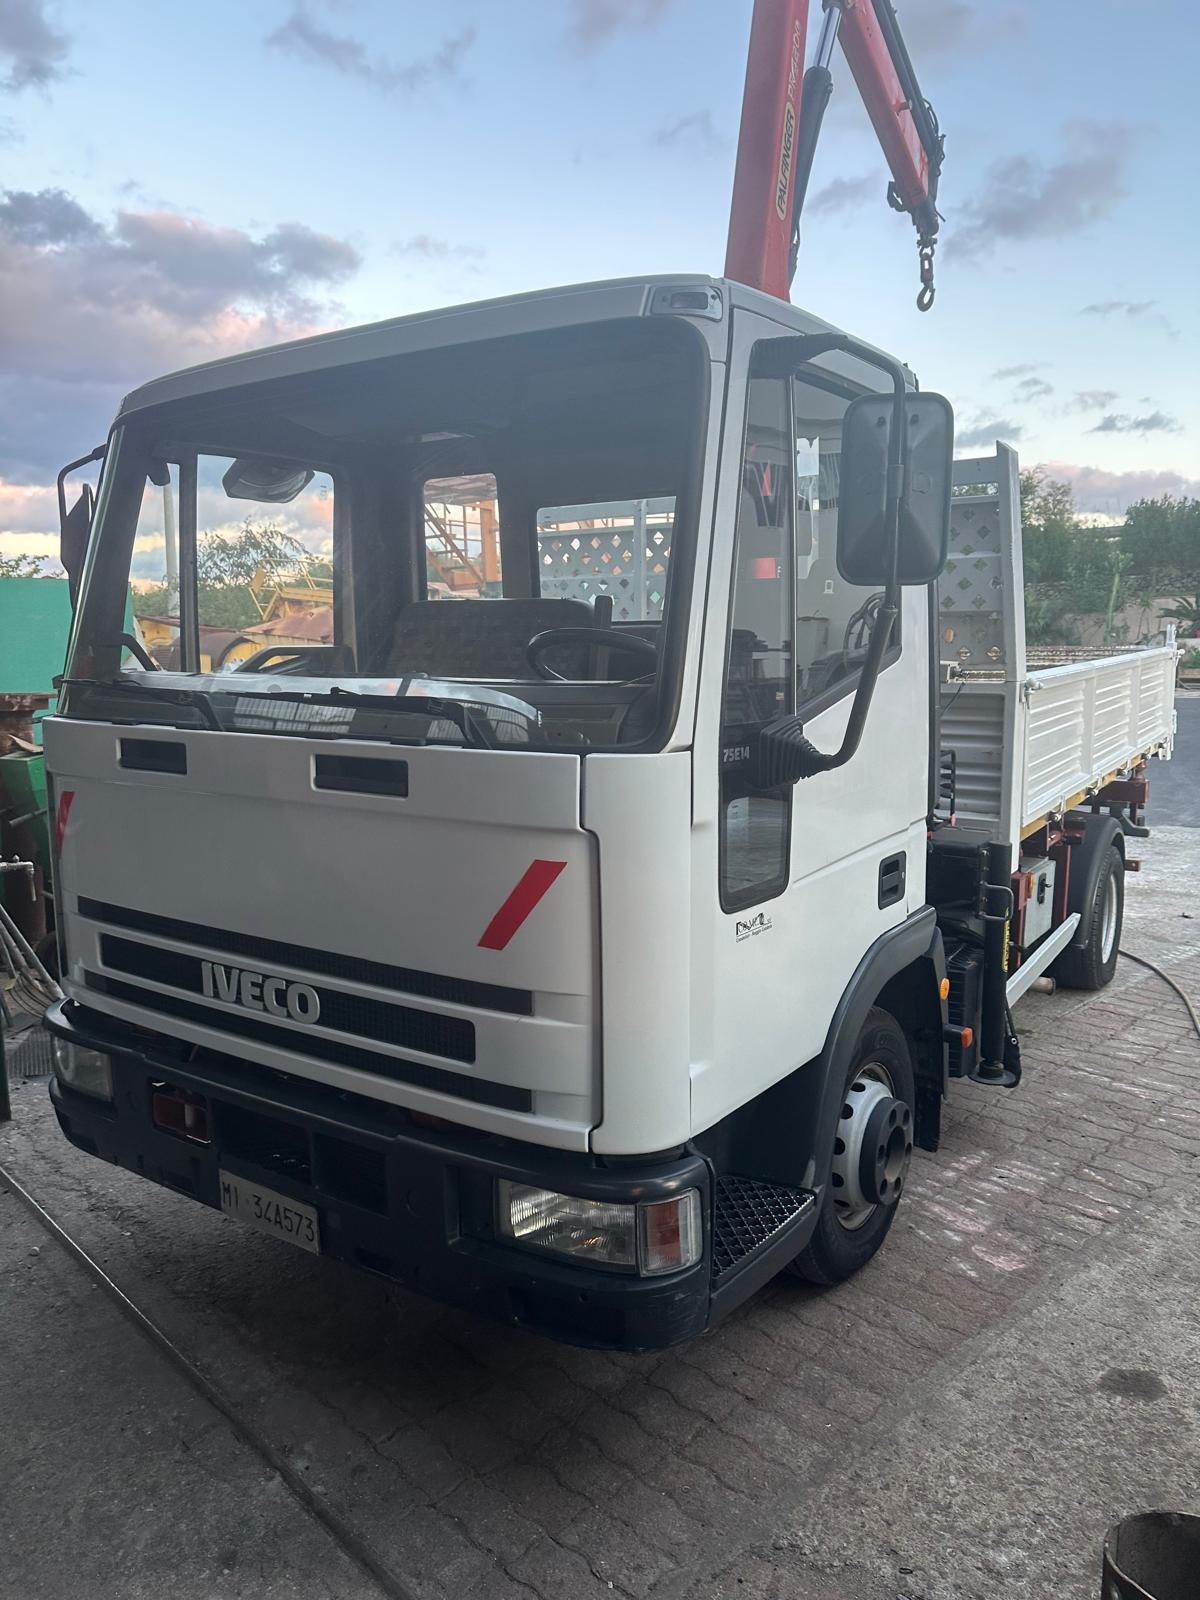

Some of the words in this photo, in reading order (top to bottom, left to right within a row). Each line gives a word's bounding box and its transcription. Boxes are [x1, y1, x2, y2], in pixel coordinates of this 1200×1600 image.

[777, 107, 794, 215] PALFINGER
[723, 746, 750, 762] 75E14
[201, 961, 320, 1024] IVECO
[222, 1182, 239, 1209] MI
[252, 1193, 315, 1242] 34A573
